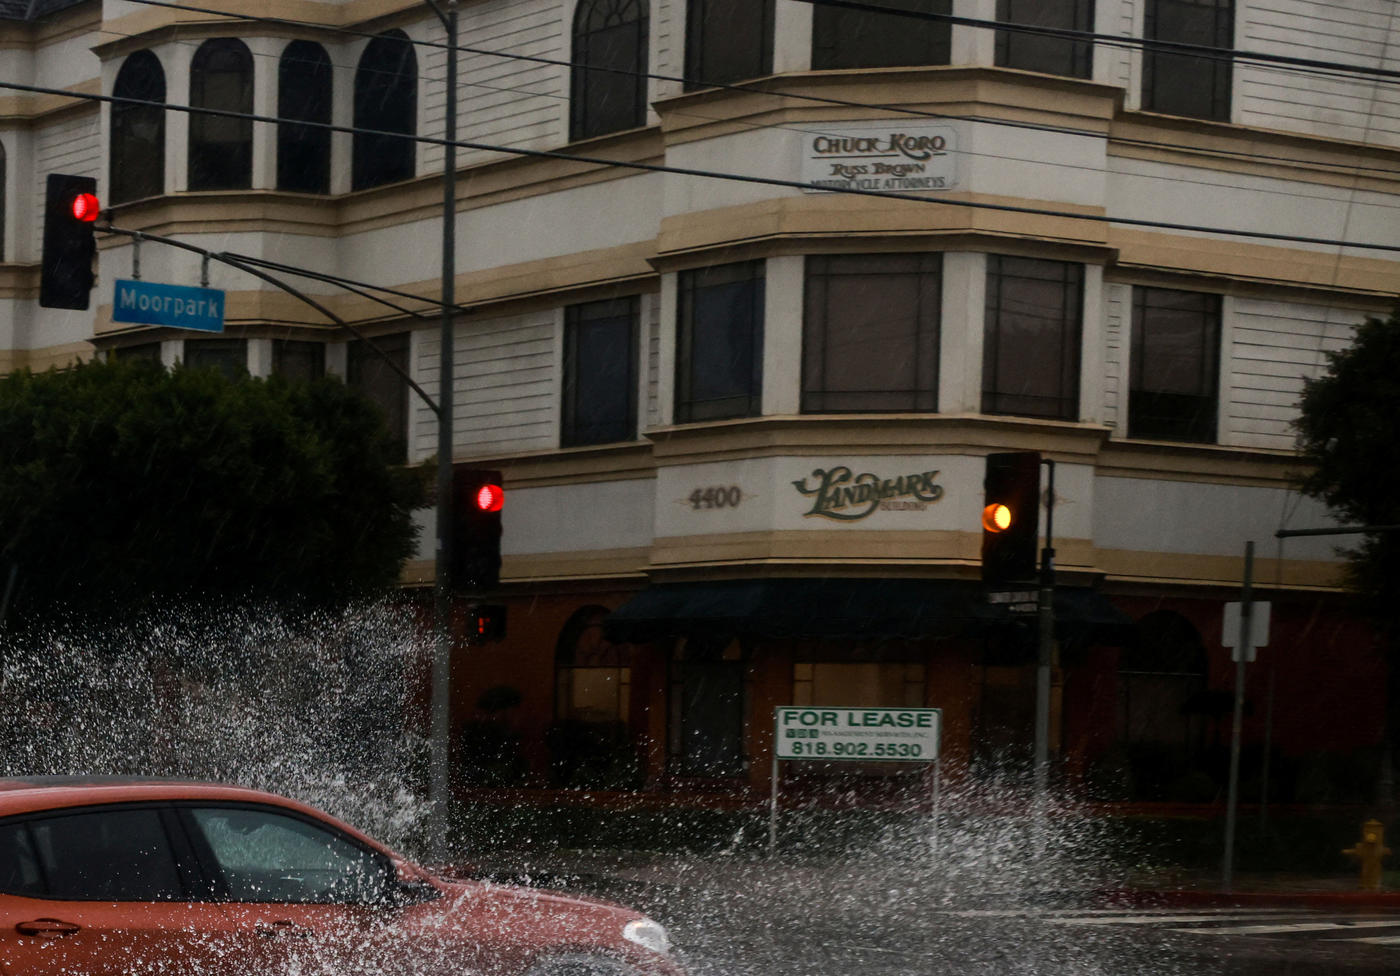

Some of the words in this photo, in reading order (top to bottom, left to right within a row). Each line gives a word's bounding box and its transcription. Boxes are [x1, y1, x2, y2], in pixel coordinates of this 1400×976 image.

[813, 135, 881, 155] CHUCK
[888, 133, 947, 162] KORO
[829, 163, 869, 179] RUSS
[871, 162, 926, 178] BROWN
[885, 176, 946, 189] ATTORNEYS
[119, 287, 219, 318] Moorpark
[688, 485, 742, 510] 4400
[791, 465, 945, 523] LANDMARK
[783, 711, 839, 727] FOR
[848, 712, 933, 728] LEASE
[791, 741, 923, 758] 818.902.5530
